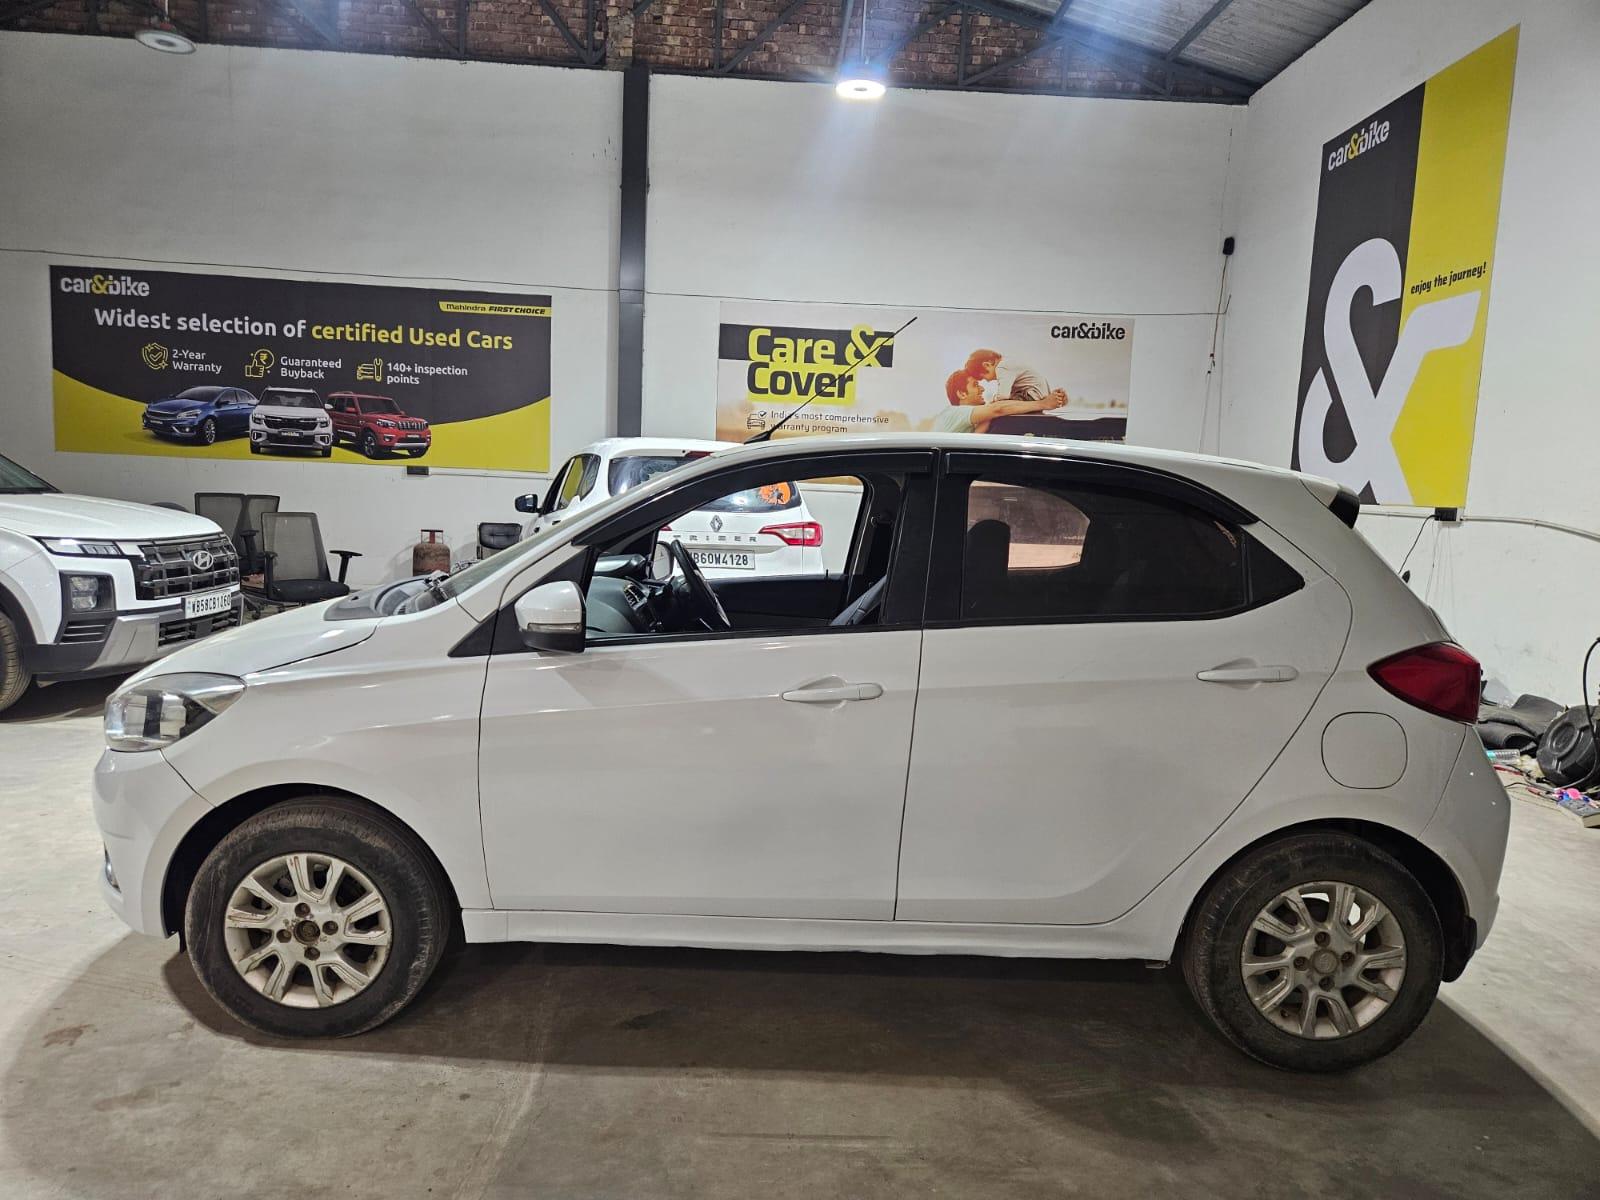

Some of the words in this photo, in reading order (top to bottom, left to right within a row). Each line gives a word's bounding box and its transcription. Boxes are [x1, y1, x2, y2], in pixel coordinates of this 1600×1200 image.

[1328, 120, 1390, 171] car&bike
[1411, 280, 1432, 295] enjoy
[1434, 273, 1448, 288] the
[1449, 262, 1487, 287] journey!
[60, 275, 150, 297] car&bike
[446, 303, 487, 313] Mahindra
[488, 305, 514, 314] FIRST
[514, 306, 546, 316] CHOICE
[94, 308, 171, 330] Widest
[177, 313, 277, 337] selection
[283, 320, 306, 338] of
[311, 322, 403, 344] certified
[409, 326, 461, 347] Used
[466, 330, 513, 350] Cars
[1051, 322, 1126, 340] car&bike
[748, 328, 835, 364] Care
[845, 323, 894, 368] &
[172, 349, 206, 360] 2-Year
[172, 360, 222, 374] Warranty
[280, 355, 342, 369] Guaranteed
[387, 362, 412, 374] 140+
[414, 363, 468, 376] inspection
[280, 367, 325, 380] Buyback
[386, 374, 420, 385] points
[747, 361, 853, 398] Cover
[801, 412, 823, 421] most
[825, 413, 889, 424] comprehensive
[812, 423, 848, 434] program
[689, 552, 748, 566] B60W4128
